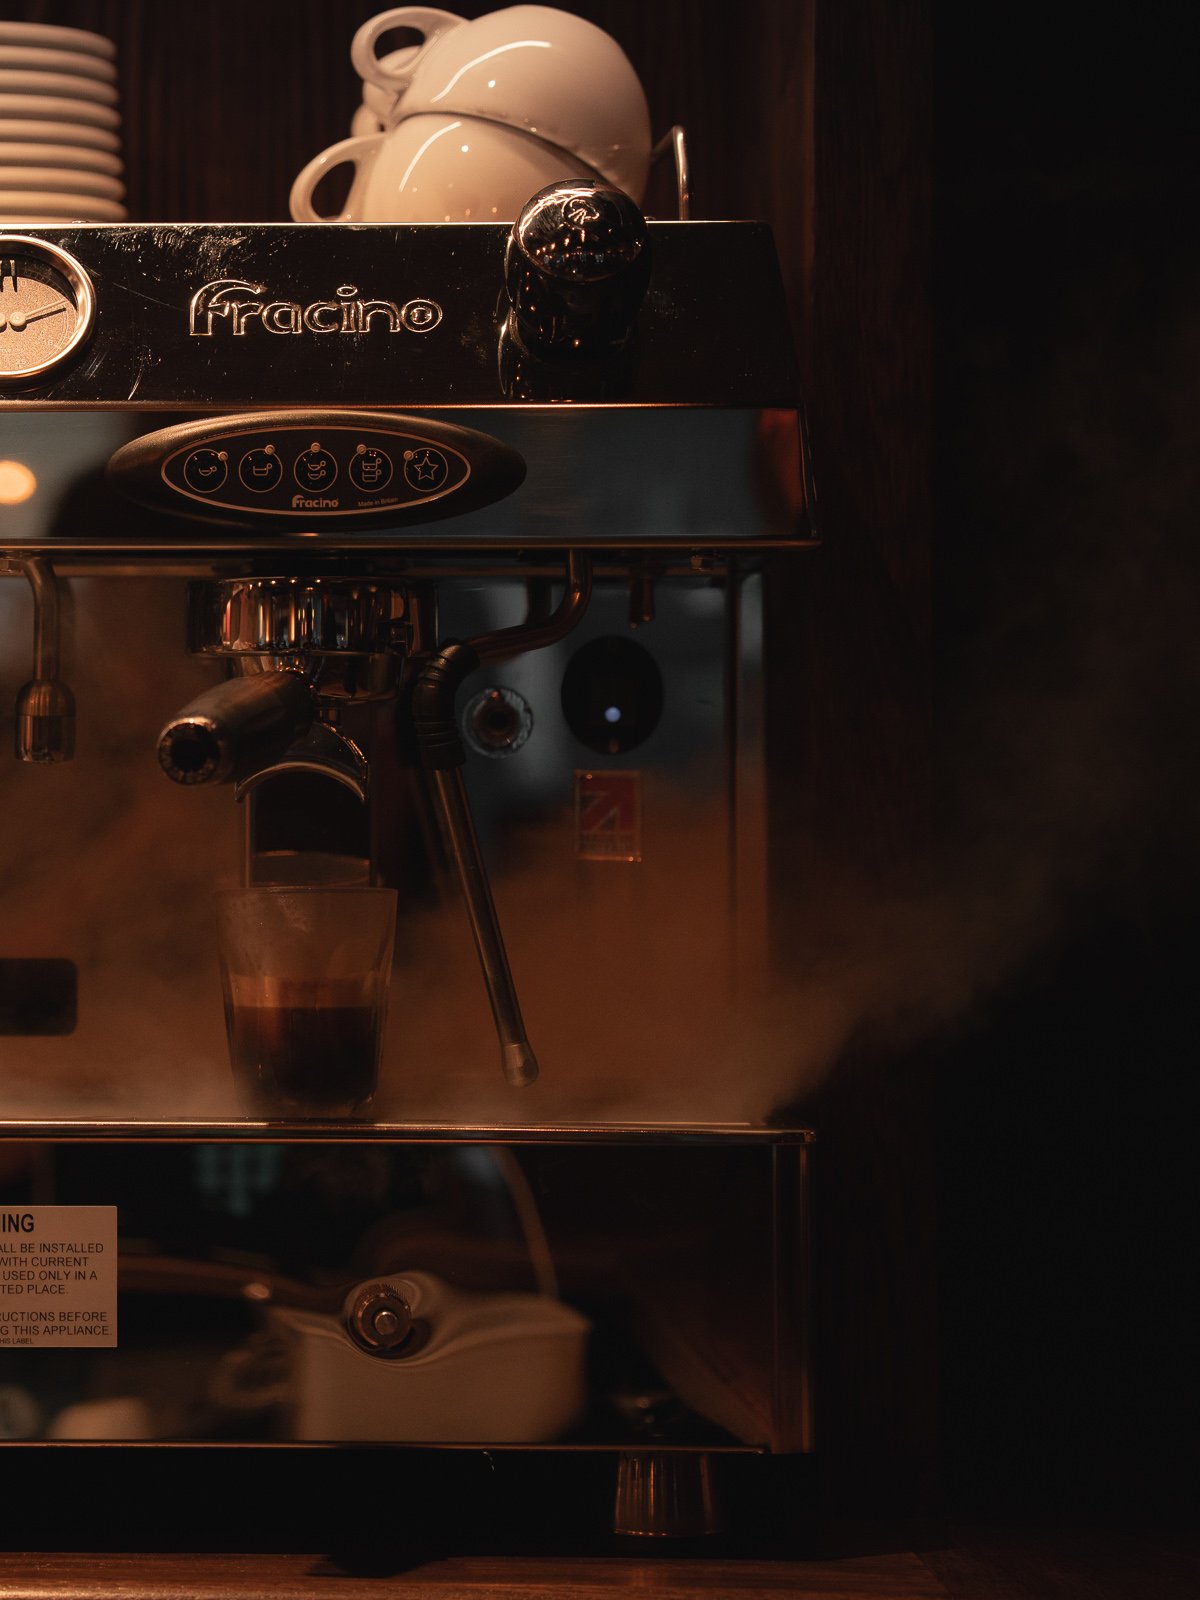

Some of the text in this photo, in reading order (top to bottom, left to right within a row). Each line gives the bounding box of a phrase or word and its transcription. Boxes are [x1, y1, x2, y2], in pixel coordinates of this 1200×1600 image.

[20, 1243, 35, 1254] BE
[39, 1243, 104, 1254] INSTALLED
[31, 1256, 89, 1267] CURRENT
[2, 1270, 35, 1281] USED
[38, 1270, 71, 1281] ONLY
[74, 1270, 86, 1281] IN
[89, 1270, 98, 1281] A
[27, 1284, 69, 1295] PLACE.
[58, 1311, 107, 1322] BEFORE
[12, 1325, 40, 1336] THIS
[42, 1325, 112, 1336] APPLIANCE.
